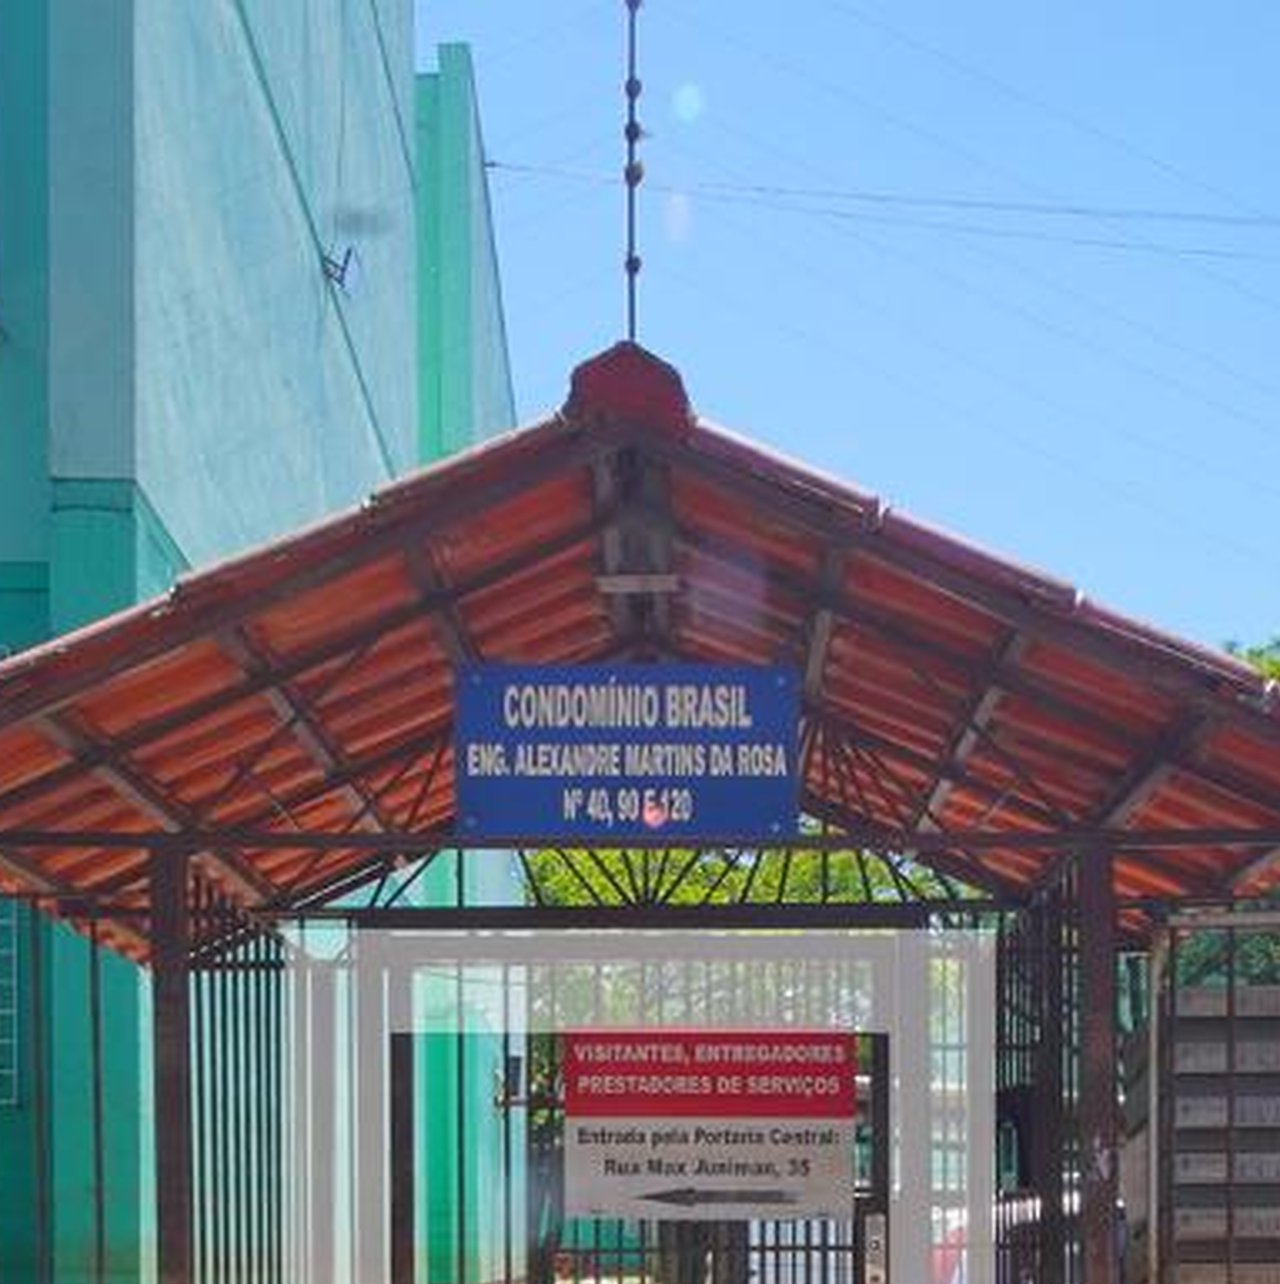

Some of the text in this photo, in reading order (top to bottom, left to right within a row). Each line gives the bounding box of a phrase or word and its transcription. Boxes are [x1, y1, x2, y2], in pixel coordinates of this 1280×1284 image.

[503, 675, 753, 728] CONDOMÍNIO BRASIL
[467, 744, 787, 776] ENG. ALEXANDRE MARTINS DA ROSA
[587, 788, 613, 828] 40,
[617, 788, 639, 821] 90
[660, 788, 693, 821] 120
[573, 1044, 846, 1065] VISITANTES, ENTREGADORES
[577, 1075, 841, 1097] PRESTADORES DE SERVIÇOS
[577, 1128, 841, 1149] Entrada pela Portaria Central:
[604, 1158, 640, 1175] Rua
[646, 1158, 686, 1176] Max
[787, 1158, 811, 1176] 35
